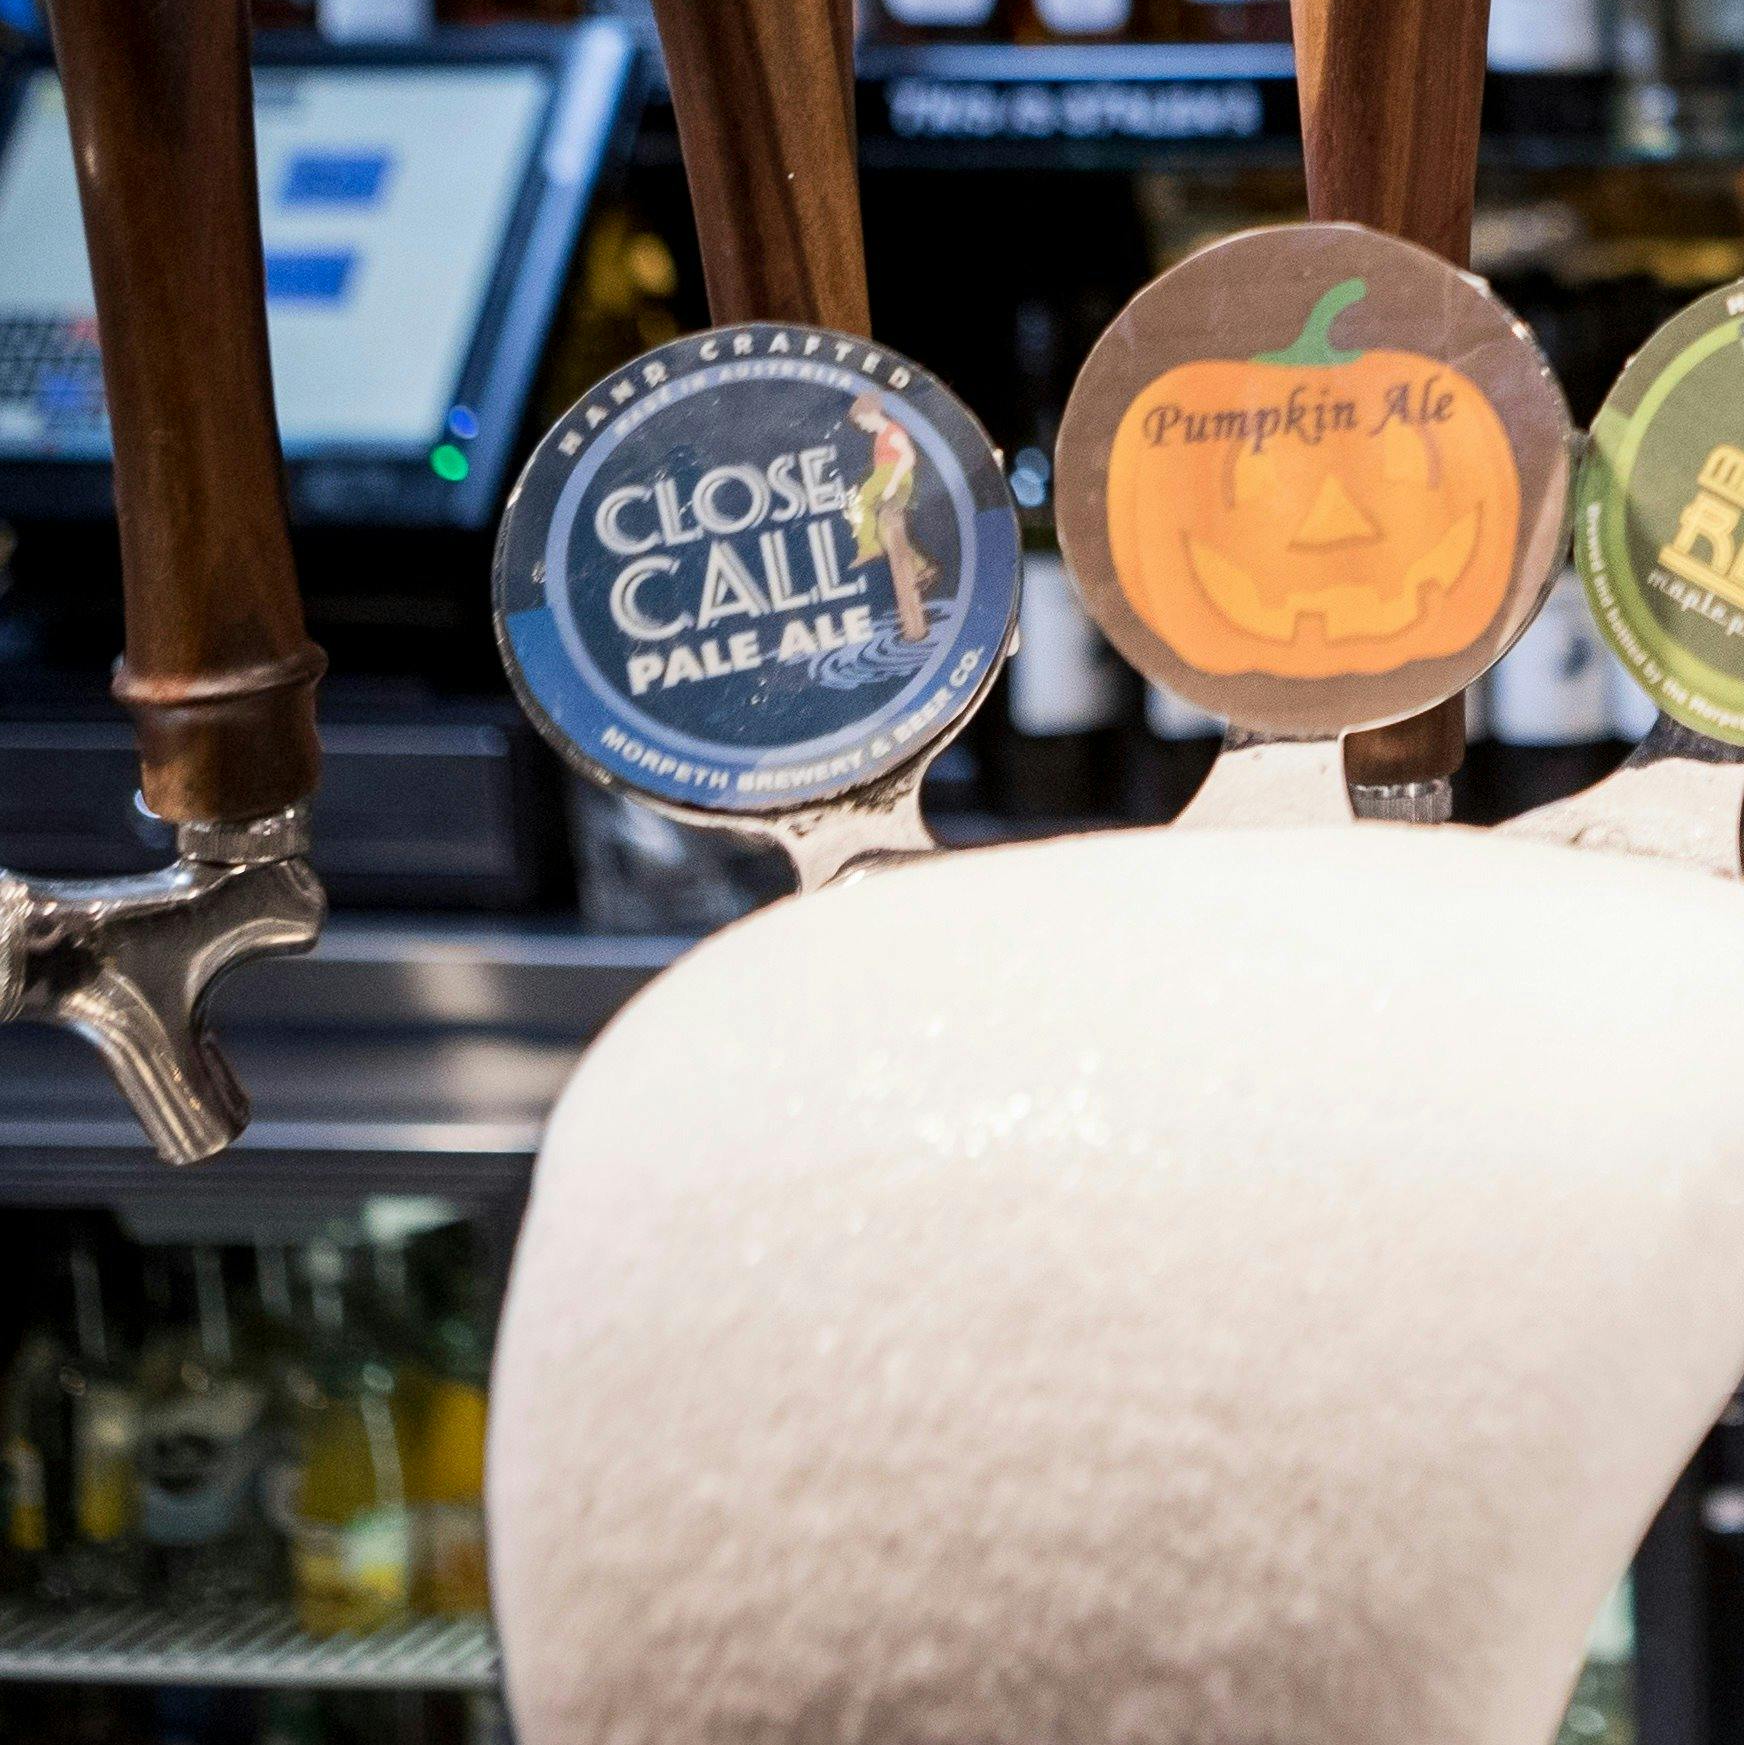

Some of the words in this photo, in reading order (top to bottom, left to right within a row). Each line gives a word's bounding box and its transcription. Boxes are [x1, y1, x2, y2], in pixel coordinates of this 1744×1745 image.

[700, 331, 911, 390] CRAFTED
[1142, 384, 1357, 455] Pumpkin
[1367, 375, 1456, 436] Ale
[594, 446, 848, 556] CLOSE
[609, 519, 867, 641] CALL
[627, 632, 762, 696] PALE
[778, 606, 874, 663] ALE
[600, 726, 729, 791] MORPETH
[737, 749, 863, 794] BREWERY
